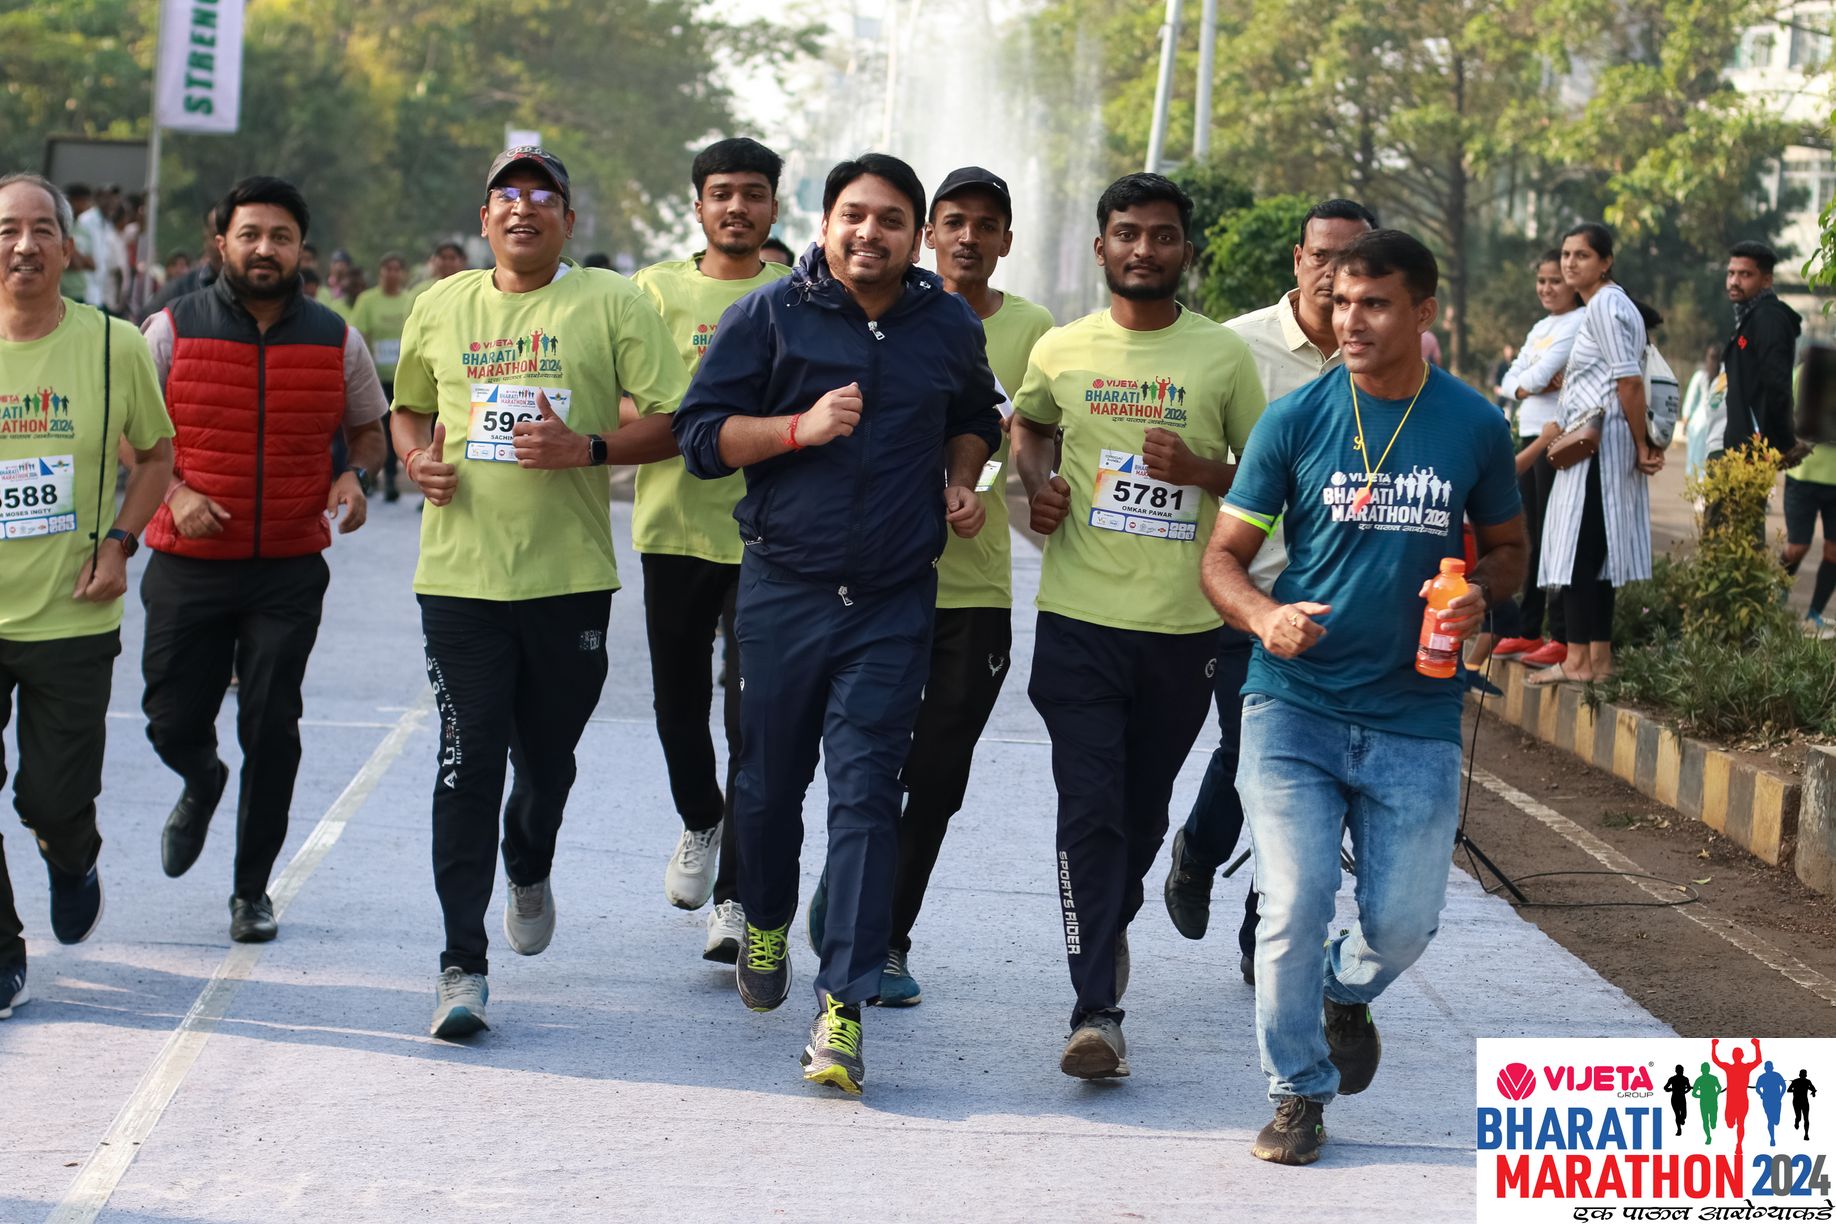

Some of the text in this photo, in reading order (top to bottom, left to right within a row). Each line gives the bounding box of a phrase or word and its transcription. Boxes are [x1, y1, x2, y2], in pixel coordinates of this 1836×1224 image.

[183, 0, 219, 116] STREN
[462, 349, 516, 366] BHARATI
[467, 359, 537, 379] MARATHON
[540, 359, 562, 371] 2024
[1106, 380, 1138, 389] VIJETA
[1085, 390, 1140, 404] BHARATI
[1090, 402, 1187, 421] MARATHON 2024
[0, 419, 48, 433] ATHON
[1348, 472, 1392, 483] VIJETA
[0, 484, 58, 509] 588
[1113, 480, 1184, 511] 5781
[1323, 487, 1395, 505] BHAATI
[1122, 505, 1173, 518] OMKAR PAWAR
[1331, 504, 1451, 528] MARATHON 2024
[1059, 850, 1081, 955] SPORTS RIDER
